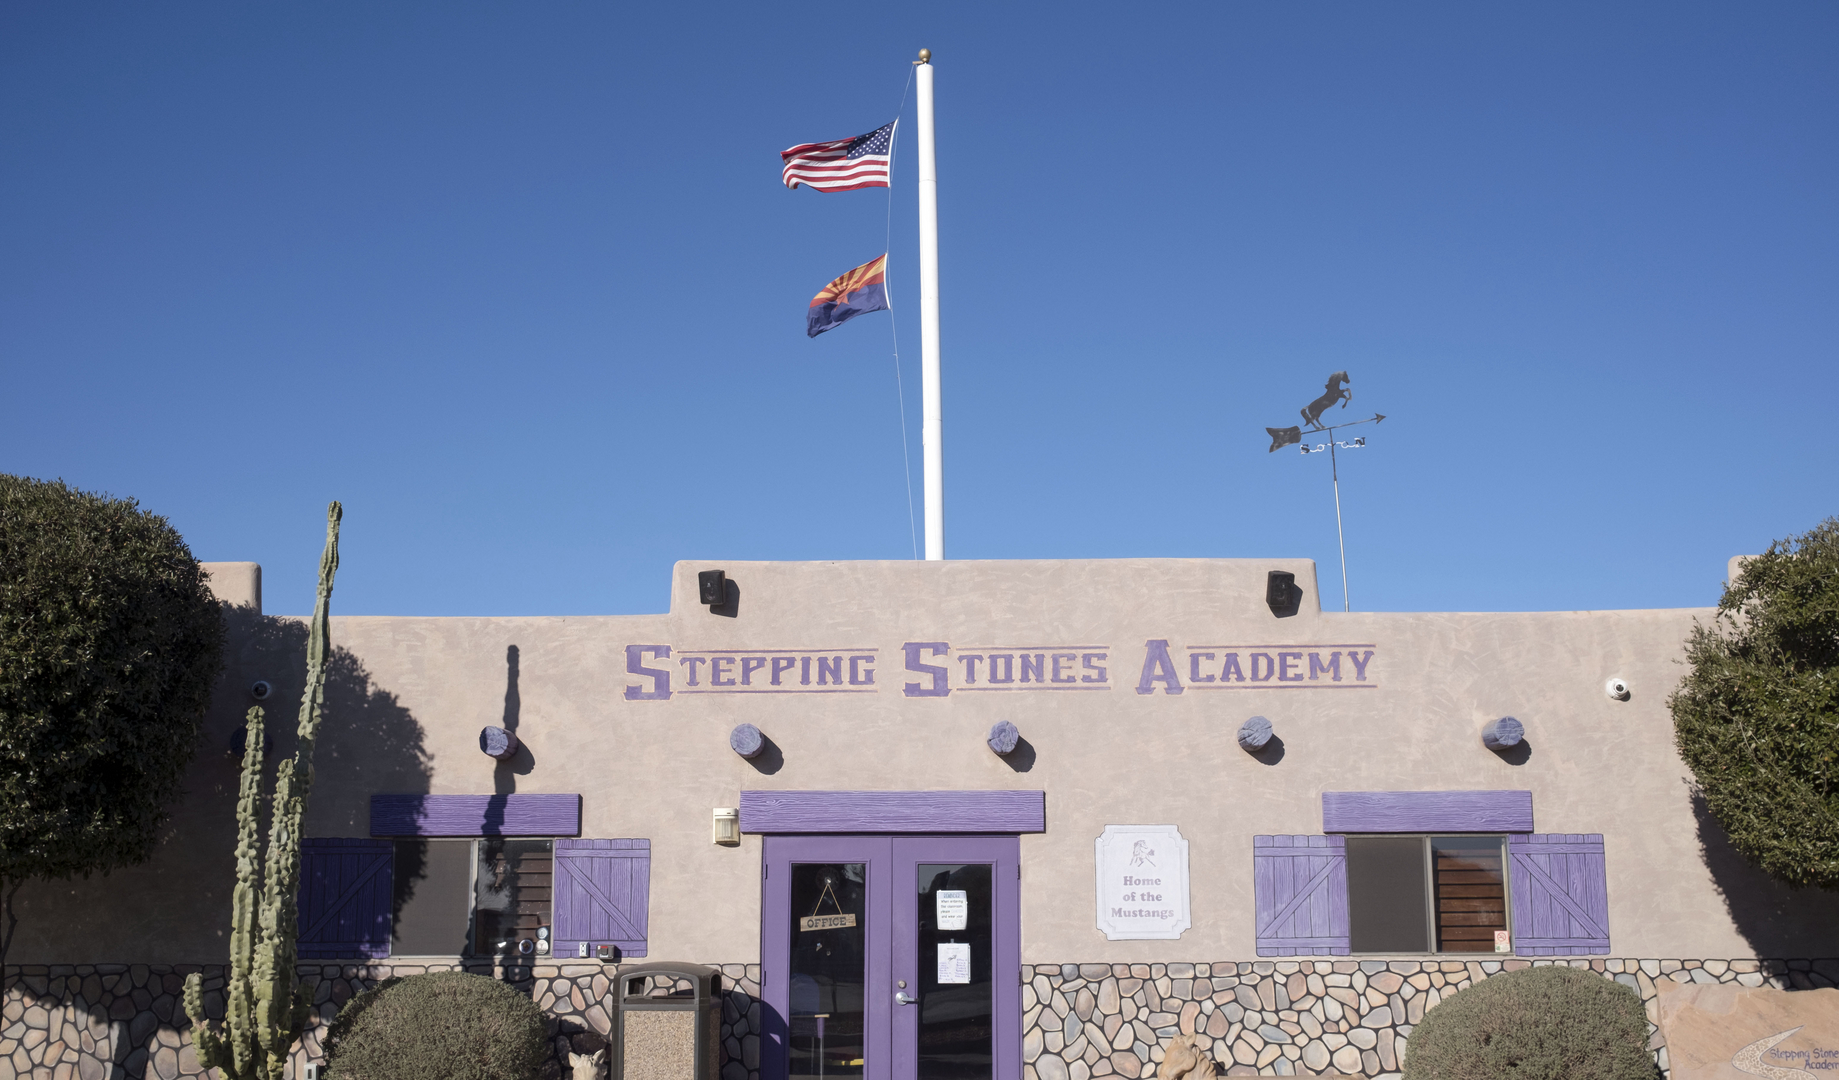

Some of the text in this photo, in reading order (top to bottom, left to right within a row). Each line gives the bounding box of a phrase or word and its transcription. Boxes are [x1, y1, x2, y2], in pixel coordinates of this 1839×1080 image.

[1354, 437, 1366, 448] N
[1300, 444, 1310, 455] S
[622, 639, 1375, 701] STEPPING STONES ACADEMY
[1123, 875, 1161, 886] Home
[1122, 892, 1163, 902] of the
[1111, 907, 1175, 920] Mustangs
[807, 916, 847, 928] OFFICE
[1769, 1047, 1810, 1062] Stepping
